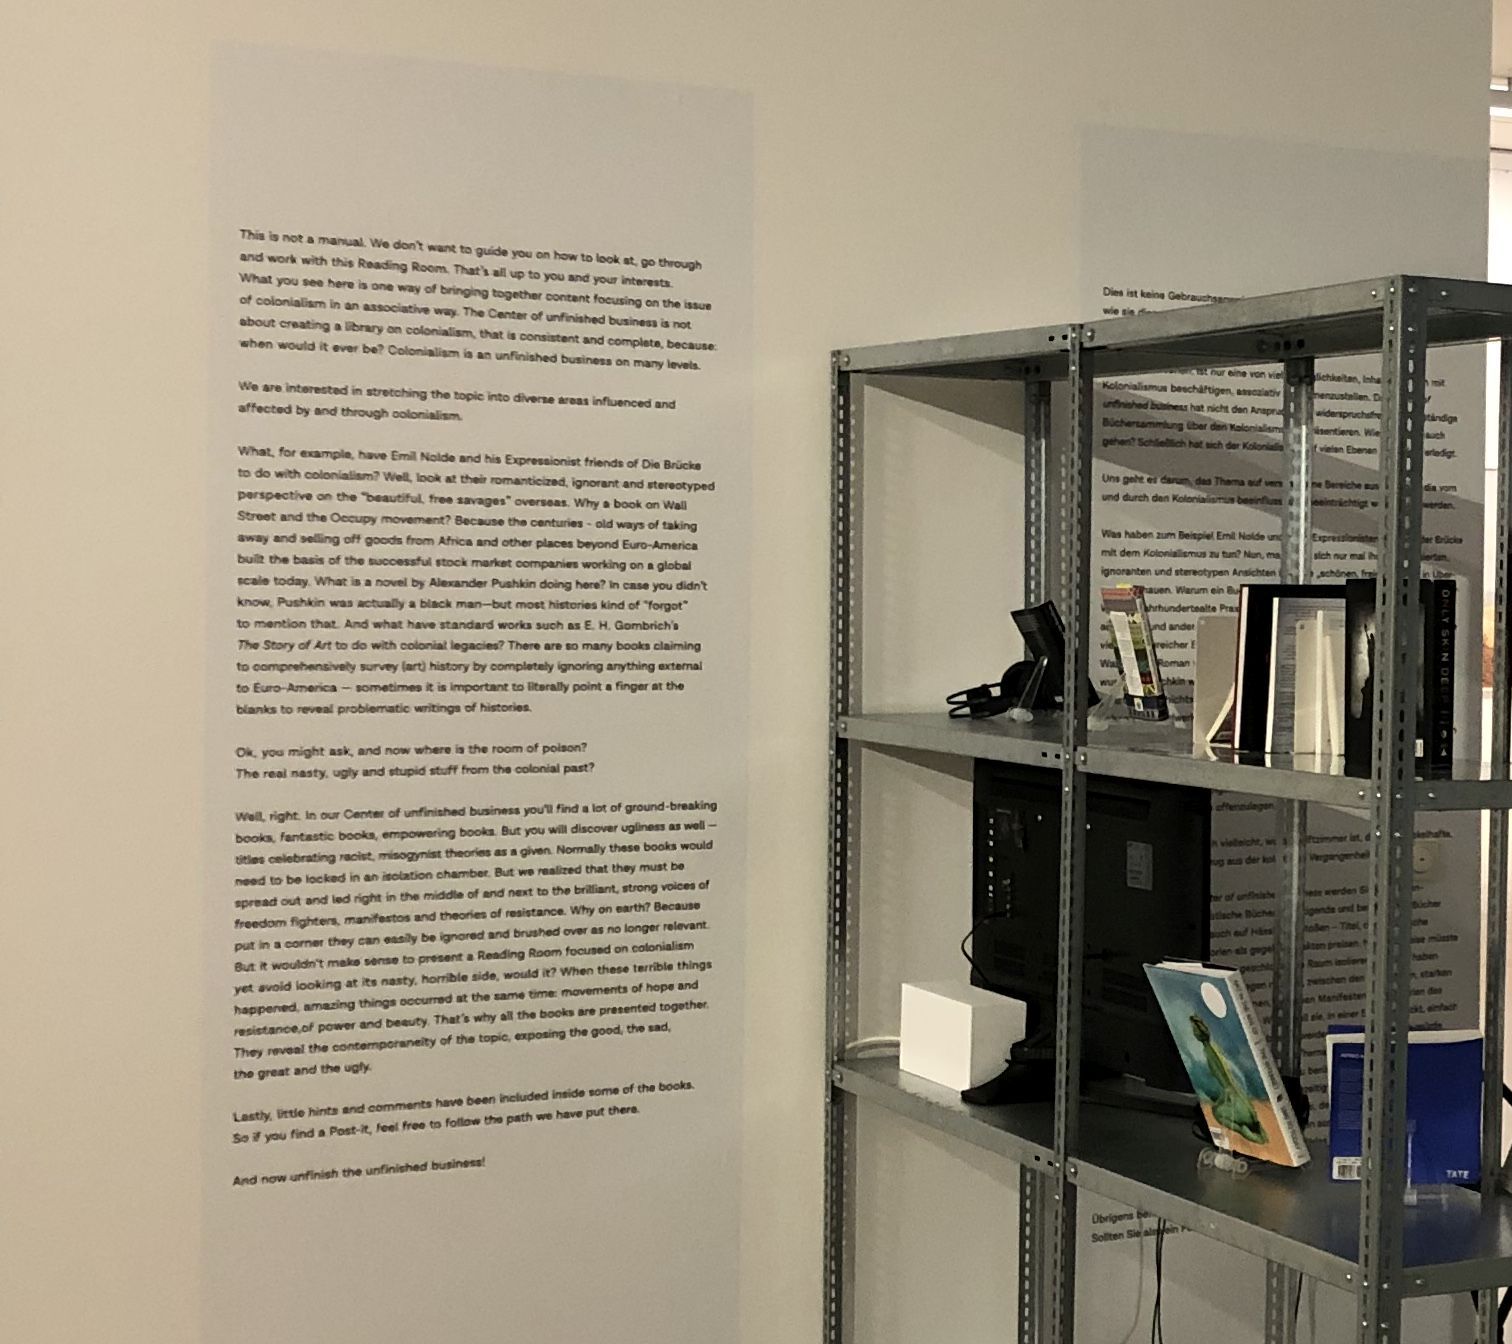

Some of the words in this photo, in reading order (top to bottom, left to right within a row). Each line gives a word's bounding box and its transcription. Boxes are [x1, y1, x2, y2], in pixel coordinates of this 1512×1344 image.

[239, 229, 265, 241] This
[268, 232, 279, 242] is
[282, 233, 303, 243] not
[306, 236, 314, 244] a
[369, 238, 390, 249] We
[392, 239, 423, 251] don't
[427, 242, 456, 253] want
[459, 244, 472, 254] to
[474, 245, 508, 259] guide
[511, 249, 532, 260] you
[535, 251, 550, 259] on
[553, 250, 577, 261] how
[580, 252, 593, 262] to
[595, 253, 620, 264] look
[640, 258, 655, 269] go
[658, 257, 702, 272] through
[1102, 286, 1124, 298] Dies
[1126, 288, 1138, 299] ist
[1140, 290, 1165, 300] keine
[1102, 307, 1119, 316] wie
[238, 338, 273, 349] when
[277, 339, 315, 351] would
[319, 342, 328, 352] it
[331, 344, 358, 353] ever
[361, 343, 384, 354] be?
[387, 344, 459, 358] Colonialism
[463, 349, 473, 359] is
[476, 351, 491, 359] an
[494, 350, 557, 363] unfinished
[560, 353, 612, 365] business
[615, 358, 630, 366] on
[632, 359, 663, 370] many
[1196, 368, 1207, 376] ist
[1210, 369, 1226, 377] nur
[1228, 369, 1246, 378] eine
[1249, 371, 1266, 379] von
[1102, 381, 1167, 393] Kolonialismus
[238, 402, 292, 414] affected
[295, 405, 310, 417] by
[313, 405, 337, 416] and
[340, 406, 389, 420] through
[1190, 403, 1205, 413] hat
[1206, 404, 1229, 413] nicht
[1231, 404, 1248, 414] den
[1186, 421, 1207, 431] über
[1210, 422, 1227, 431] den
[278, 446, 296, 457] for
[357, 450, 387, 460] have
[390, 450, 416, 461] Emil
[419, 451, 455, 462] Nolde
[458, 453, 481, 463] and
[483, 453, 501, 464] his
[504, 454, 581, 468] Expressionist
[584, 457, 624, 467] friends
[626, 458, 638, 468] of
[641, 458, 660, 469] Die
[663, 459, 701, 470] Brücke
[1102, 492, 1120, 502] und
[1122, 493, 1149, 503] durch
[1151, 493, 1170, 503] den
[1172, 493, 1235, 504] Kolonialismus
[1101, 529, 1122, 539] Was
[1124, 530, 1154, 540] haben
[1156, 532, 1176, 540] zum
[1178, 530, 1214, 542] Beispiel
[1216, 530, 1236, 540] Emil
[1238, 531, 1266, 541] Nolde
[1101, 547, 1117, 557] mit
[1119, 547, 1141, 557] dem
[1143, 547, 1207, 559] Kolonialismus
[1209, 551, 1220, 559] zu
[1221, 549, 1241, 559] tun?
[1314, 551, 1331, 560] sich
[1350, 551, 1366, 560] mal
[1101, 566, 1152, 578] ignoranten
[1154, 566, 1173, 577] und
[1174, 567, 1230, 579] stereotypen
[1232, 567, 1276, 577] Ansichten
[1176, 585, 1208, 595] Warum
[1210, 586, 1225, 595] ein
[238, 639, 260, 649] The
[262, 639, 295, 651] Story
[297, 639, 311, 650] of
[313, 640, 332, 649] Art
[334, 640, 348, 649] to
[351, 640, 367, 650] do
[370, 640, 396, 649] with
[399, 640, 447, 650] colonial
[449, 640, 504, 652] legacies?
[507, 640, 540, 650] There
[543, 642, 562, 650] are
[565, 642, 578, 650] so
[581, 642, 613, 652] many
[615, 640, 650, 650] books
[653, 641, 701, 652] claiming
[236, 768, 259, 778] The
[262, 768, 287, 778] real
[332, 767, 358, 779] ugly
[361, 766, 385, 776] and
[388, 766, 426, 777] stupid
[429, 765, 458, 775] stuff
[461, 764, 489, 774] from
[492, 764, 511, 774] the
[514, 763, 560, 773] colonial
[562, 762, 594, 774] past?
[234, 916, 287, 929] freedom
[343, 911, 411, 924] manifestos
[413, 911, 436, 921] and
[439, 909, 487, 920] theories
[489, 908, 502, 918] of
[569, 904, 595, 917] Why
[597, 905, 612, 914] on
[615, 902, 650, 913] earth?
[653, 900, 700, 912] Because
[232, 1174, 257, 1186] And
[260, 1174, 287, 1184] now
[289, 1167, 338, 1182] unfinish
[341, 1166, 362, 1177] the
[365, 1160, 428, 1175] unfinished
[431, 1156, 485, 1170] business!
[1445, 1169, 1470, 1179] TATE
[1092, 1211, 1134, 1224] Übrigens
[1091, 1232, 1124, 1243] Sollten
